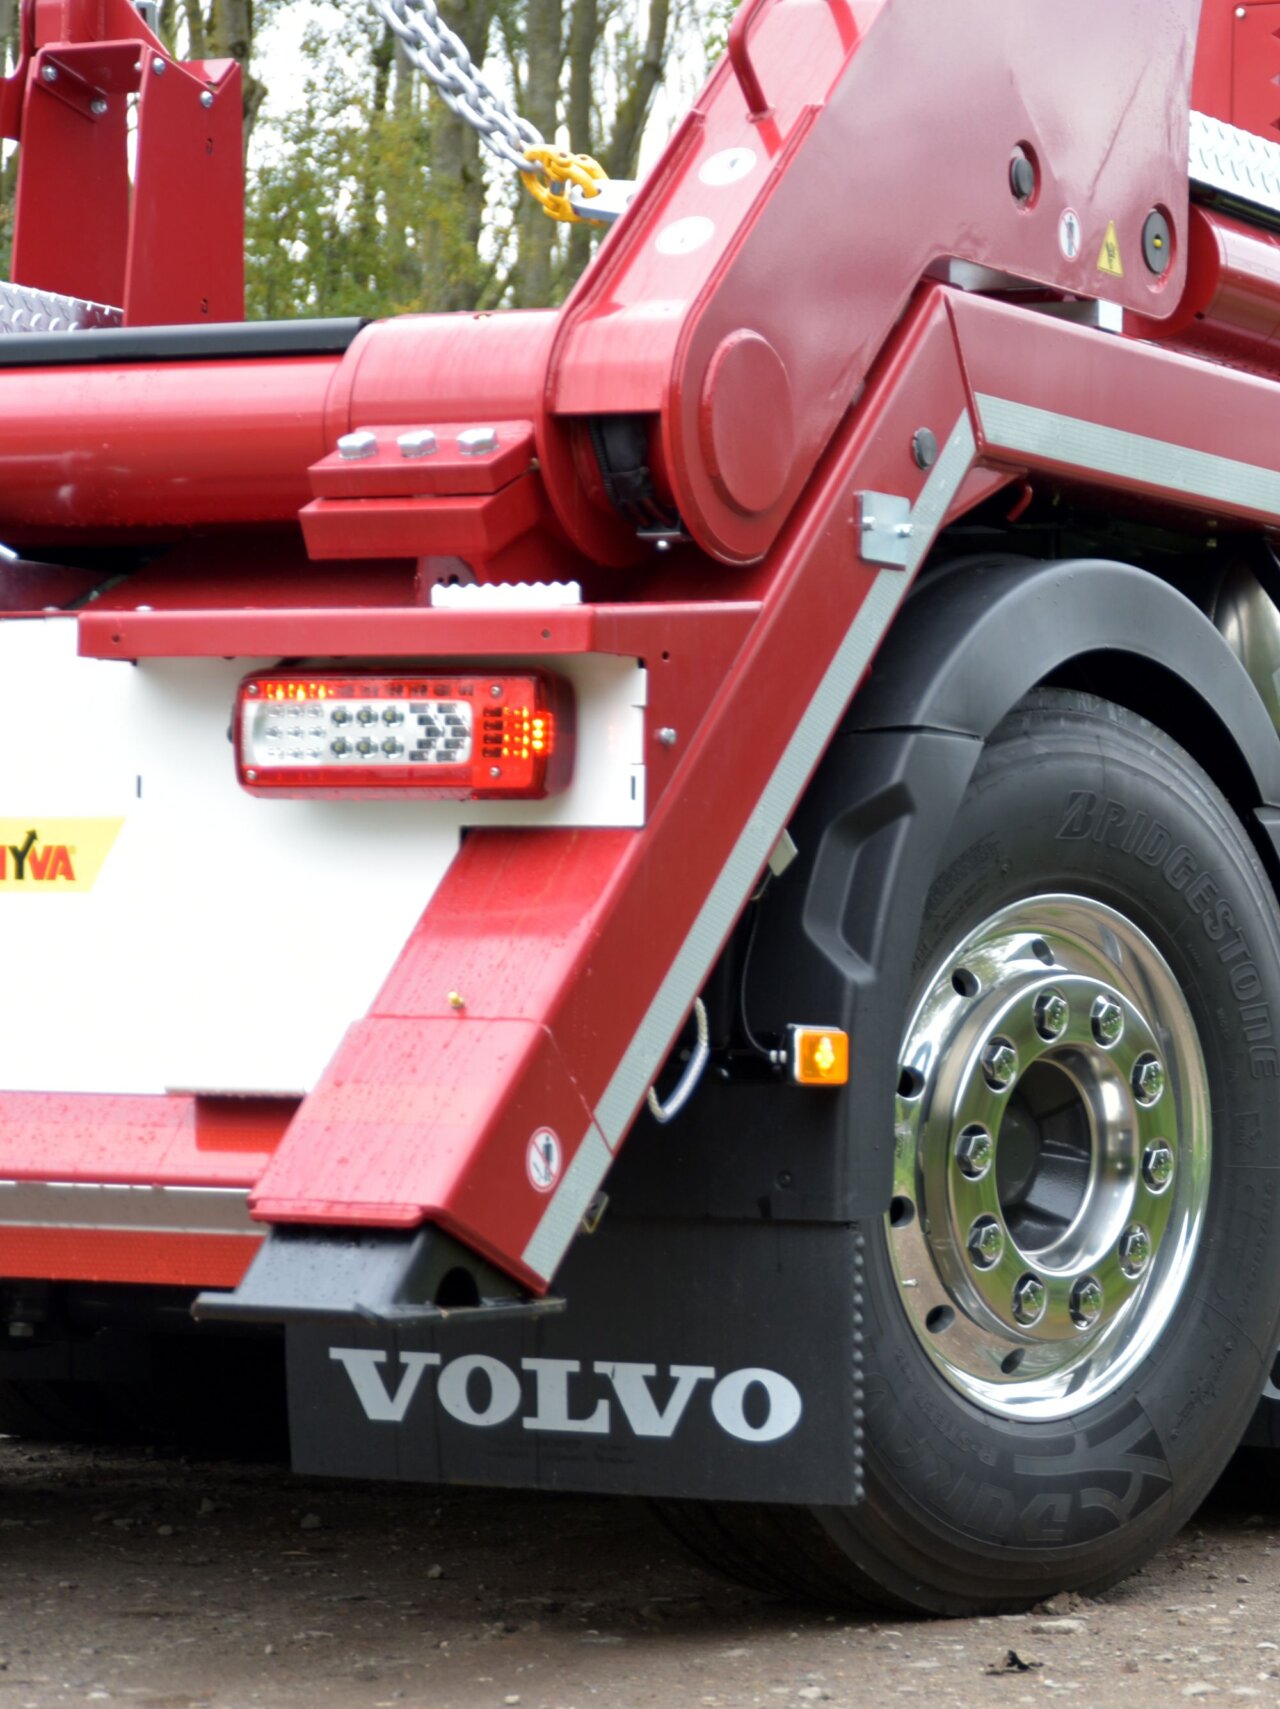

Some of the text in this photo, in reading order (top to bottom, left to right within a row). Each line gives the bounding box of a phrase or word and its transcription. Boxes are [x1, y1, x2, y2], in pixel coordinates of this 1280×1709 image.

[0, 829, 75, 881] YVA
[1056, 790, 1280, 1079] BRIDGESTONE
[329, 1347, 802, 1443] VOLVO
